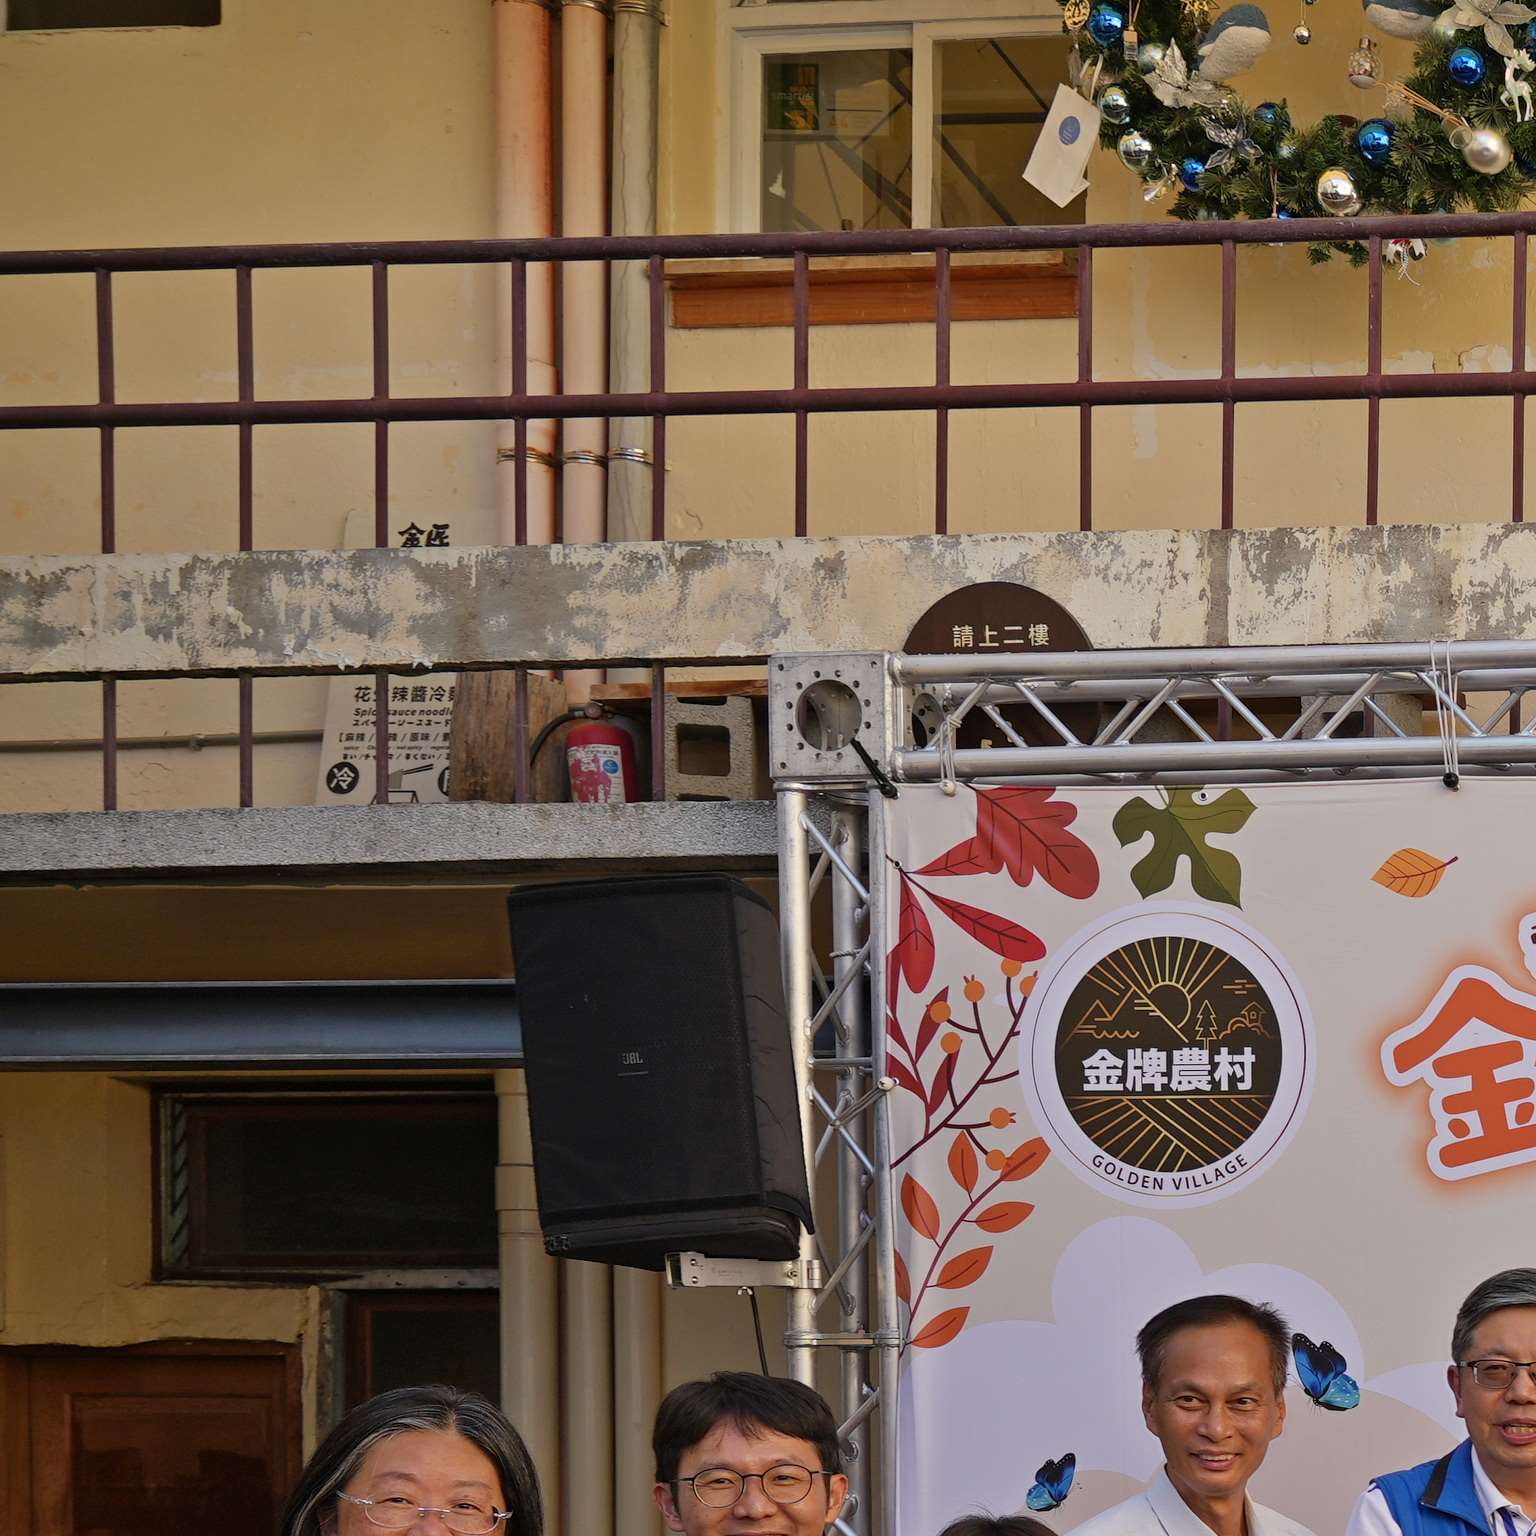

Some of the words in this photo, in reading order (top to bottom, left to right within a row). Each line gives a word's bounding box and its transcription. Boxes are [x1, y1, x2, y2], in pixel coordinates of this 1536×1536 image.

[951, 623, 1050, 648] 請上二樓
[353, 707, 377, 718] Spic
[1081, 1046, 1256, 1093] 金牌農村
[1091, 1153, 1165, 1191] GOLDEN
[1172, 1153, 1249, 1191] VILLAGE
